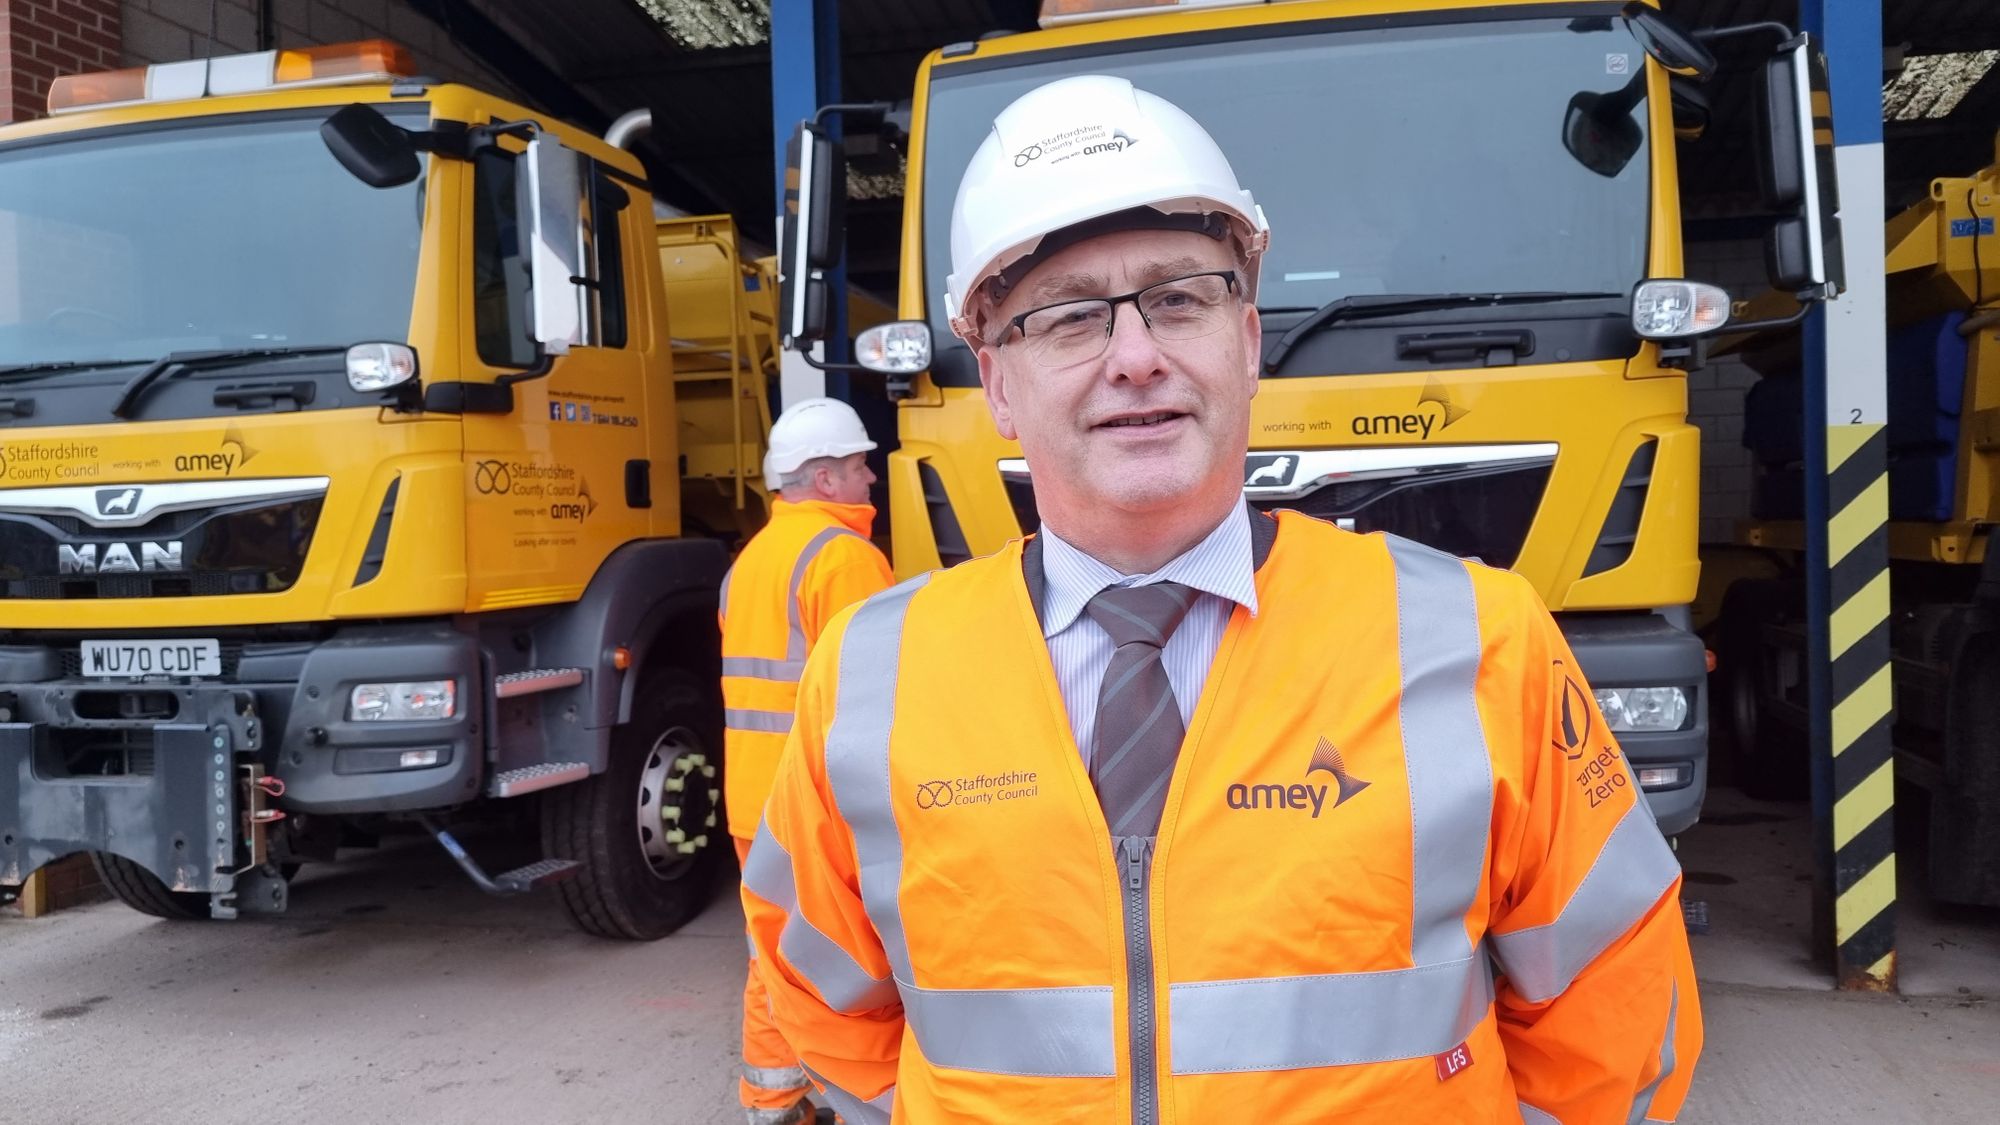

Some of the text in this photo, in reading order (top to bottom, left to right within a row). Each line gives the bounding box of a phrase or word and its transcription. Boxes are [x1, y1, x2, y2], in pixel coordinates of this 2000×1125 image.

[1041, 125, 1103, 147] Staffordshire
[1043, 131, 1106, 155] County Council
[1083, 141, 1123, 156] amey
[1263, 413, 1436, 440] working with amey
[1850, 408, 1863, 425] 2
[8, 442, 99, 462] Staffordshire
[9, 466, 51, 482] County
[55, 462, 100, 479] Council
[175, 453, 235, 476] amey
[512, 462, 575, 481] Staffordshire
[512, 482, 576, 498] County Council
[551, 504, 586, 524] amey
[58, 540, 183, 574] MAN
[92, 646, 207, 672] WU70 CDF
[955, 770, 1037, 792] Staffordshire
[1585, 773, 1626, 808] Zero
[954, 785, 1038, 806] County Council
[1226, 783, 1328, 819] amey
[1446, 1048, 1467, 1074] LFS
